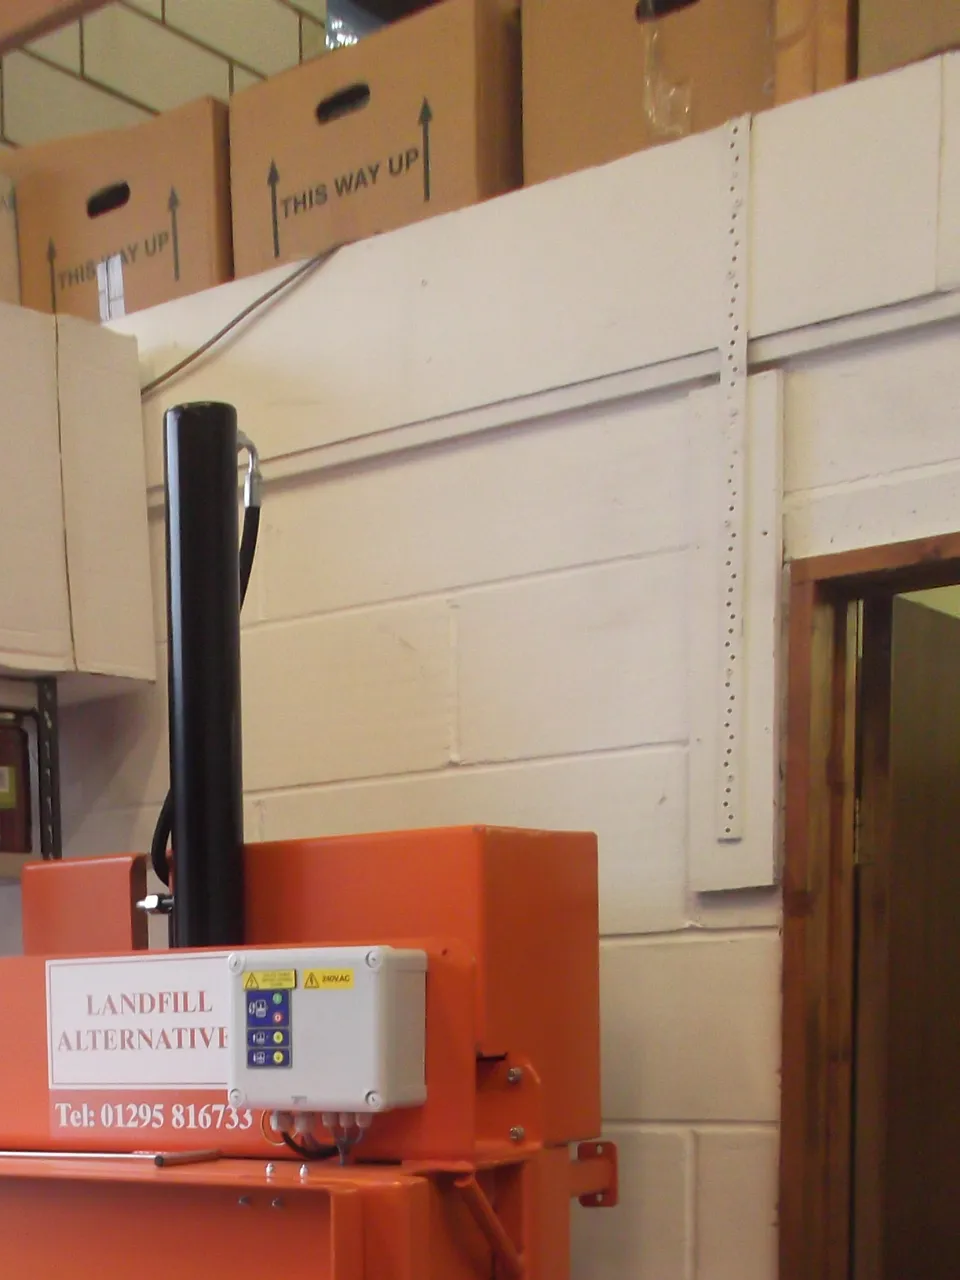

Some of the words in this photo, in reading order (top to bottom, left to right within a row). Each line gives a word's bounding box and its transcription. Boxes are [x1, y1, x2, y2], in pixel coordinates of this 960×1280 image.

[280, 183, 328, 219] THIS
[334, 161, 380, 197] WAY
[388, 147, 419, 177] UP
[58, 258, 97, 290] THIS
[145, 231, 169, 257] UP
[86, 990, 213, 1016] LANDFILL
[55, 1102, 95, 1128] Tel:
[100, 1103, 164, 1129] 01295
[171, 1103, 253, 1130] 816733
